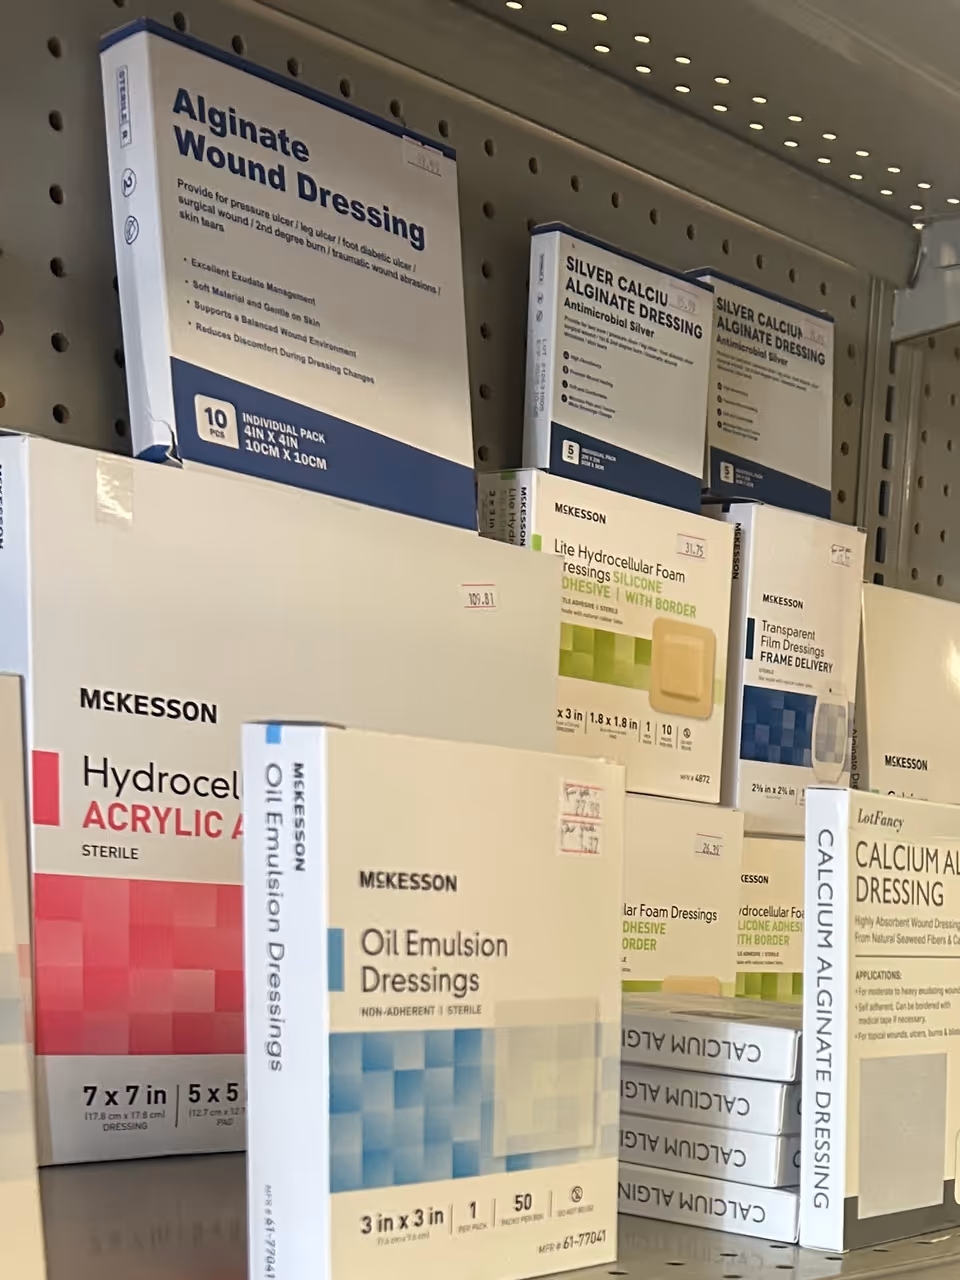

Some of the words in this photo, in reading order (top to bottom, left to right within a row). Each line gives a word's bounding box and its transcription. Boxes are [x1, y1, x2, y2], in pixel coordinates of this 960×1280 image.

[173, 87, 310, 162] Alginate
[174, 125, 286, 192] Wound
[297, 172, 425, 251] Dressing
[191, 258, 228, 278] Excellent
[231, 270, 264, 290] Exudate
[266, 281, 316, 306] Management
[566, 256, 614, 286] SILVER
[564, 297, 627, 329] Antimicrobial
[630, 321, 654, 338] Silver
[565, 278, 635, 315] ALGINATE
[639, 303, 702, 340] DRESSING
[717, 297, 754, 322] SILVER
[717, 318, 772, 347] ALGINATE
[775, 338, 825, 365] DRESSING
[204, 407, 228, 429] 10
[242, 413, 298, 436] INDIVIDUAL
[300, 428, 326, 444] PACK
[244, 425, 265, 440] 4IN
[268, 431, 276, 443] X
[278, 433, 298, 448] 4IN
[554, 539, 574, 556] Lite
[578, 544, 653, 575] Hydrocellular
[656, 564, 685, 582] Foam
[613, 571, 662, 593] SILICONE
[625, 590, 653, 607] WITH
[655, 598, 697, 618] BORDER
[762, 620, 816, 640] Transparent
[760, 636, 781, 650] Film
[783, 639, 824, 658] Dressings
[760, 652, 793, 667] FRAME
[795, 658, 833, 673] DELIVERY
[265, 763, 283, 803] Oil
[82, 801, 223, 839] ACRYLIC
[858, 808, 904, 832] LotFancy
[81, 845, 139, 860] STERILE
[855, 841, 938, 873] CALCIUM
[265, 811, 284, 933] Emulsion
[816, 829, 834, 949] CALCIUM
[856, 876, 944, 906] DRESSING
[640, 904, 669, 918] Foam
[671, 906, 717, 923] Dressings
[855, 915, 874, 928] Highly
[876, 918, 910, 928] Absorbent
[911, 919, 933, 929] Wound
[935, 919, 960, 931] Dressing
[360, 928, 400, 957] Oil
[405, 929, 509, 959] Emulsion
[360, 966, 480, 997] Dressings
[266, 942, 286, 1072] Dressings
[359, 1005, 435, 1017] NON-ADHERENT
[448, 1004, 482, 1016] STERILE
[816, 957, 833, 1081] ALGINATE
[672, 1036, 762, 1063] CALCIUM
[665, 1143, 746, 1168] CALCIUM
[814, 1090, 830, 1209] DRESSING
[680, 1193, 766, 1224] CALCIUM
[563, 1229, 606, 1250] 61-77041
